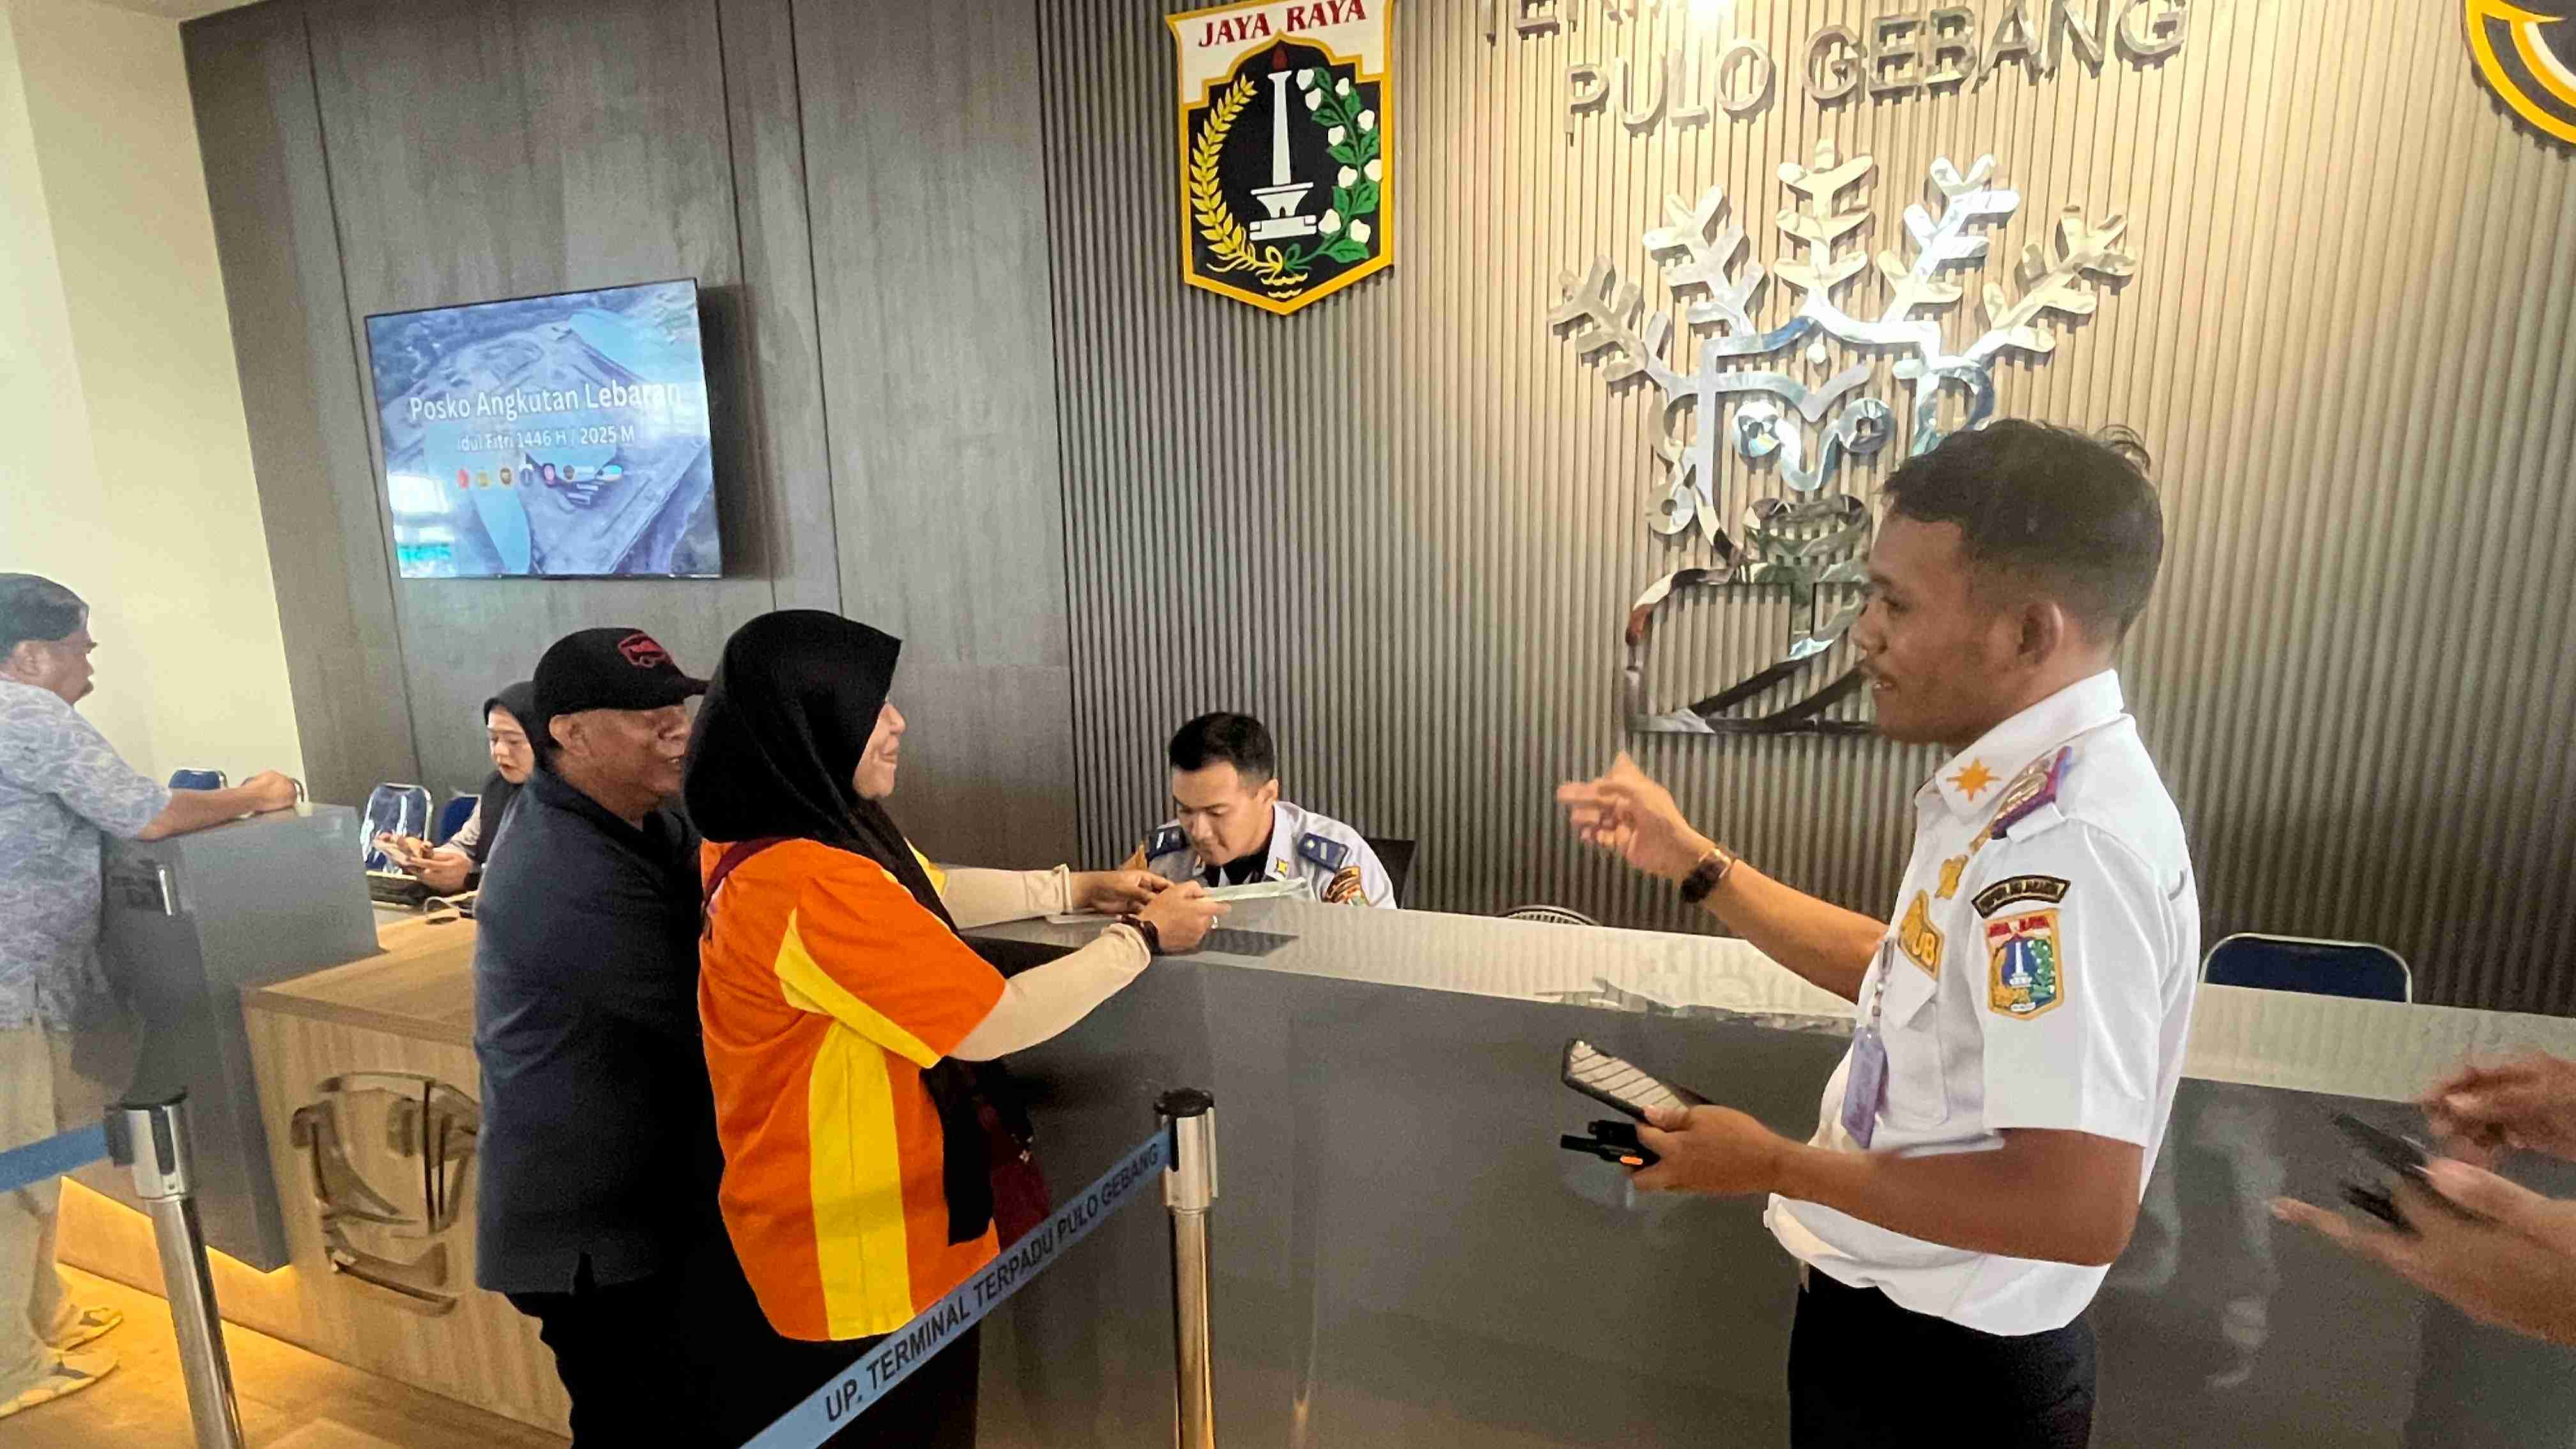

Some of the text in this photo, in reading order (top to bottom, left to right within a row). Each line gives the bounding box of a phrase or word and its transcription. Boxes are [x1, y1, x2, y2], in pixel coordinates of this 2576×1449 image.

[1199, 0, 1367, 47] JAYA RAYA
[1565, 0, 2186, 136] PULO GEBANG
[410, 379, 682, 421] Posko Angkutan Lebaran
[516, 430, 552, 448] 1446
[555, 430, 567, 445] H
[580, 425, 617, 445] 2025
[620, 425, 635, 442] M
[826, 1143, 1158, 1422] UP. TERMINAL TERPADU PULO GEBANG
